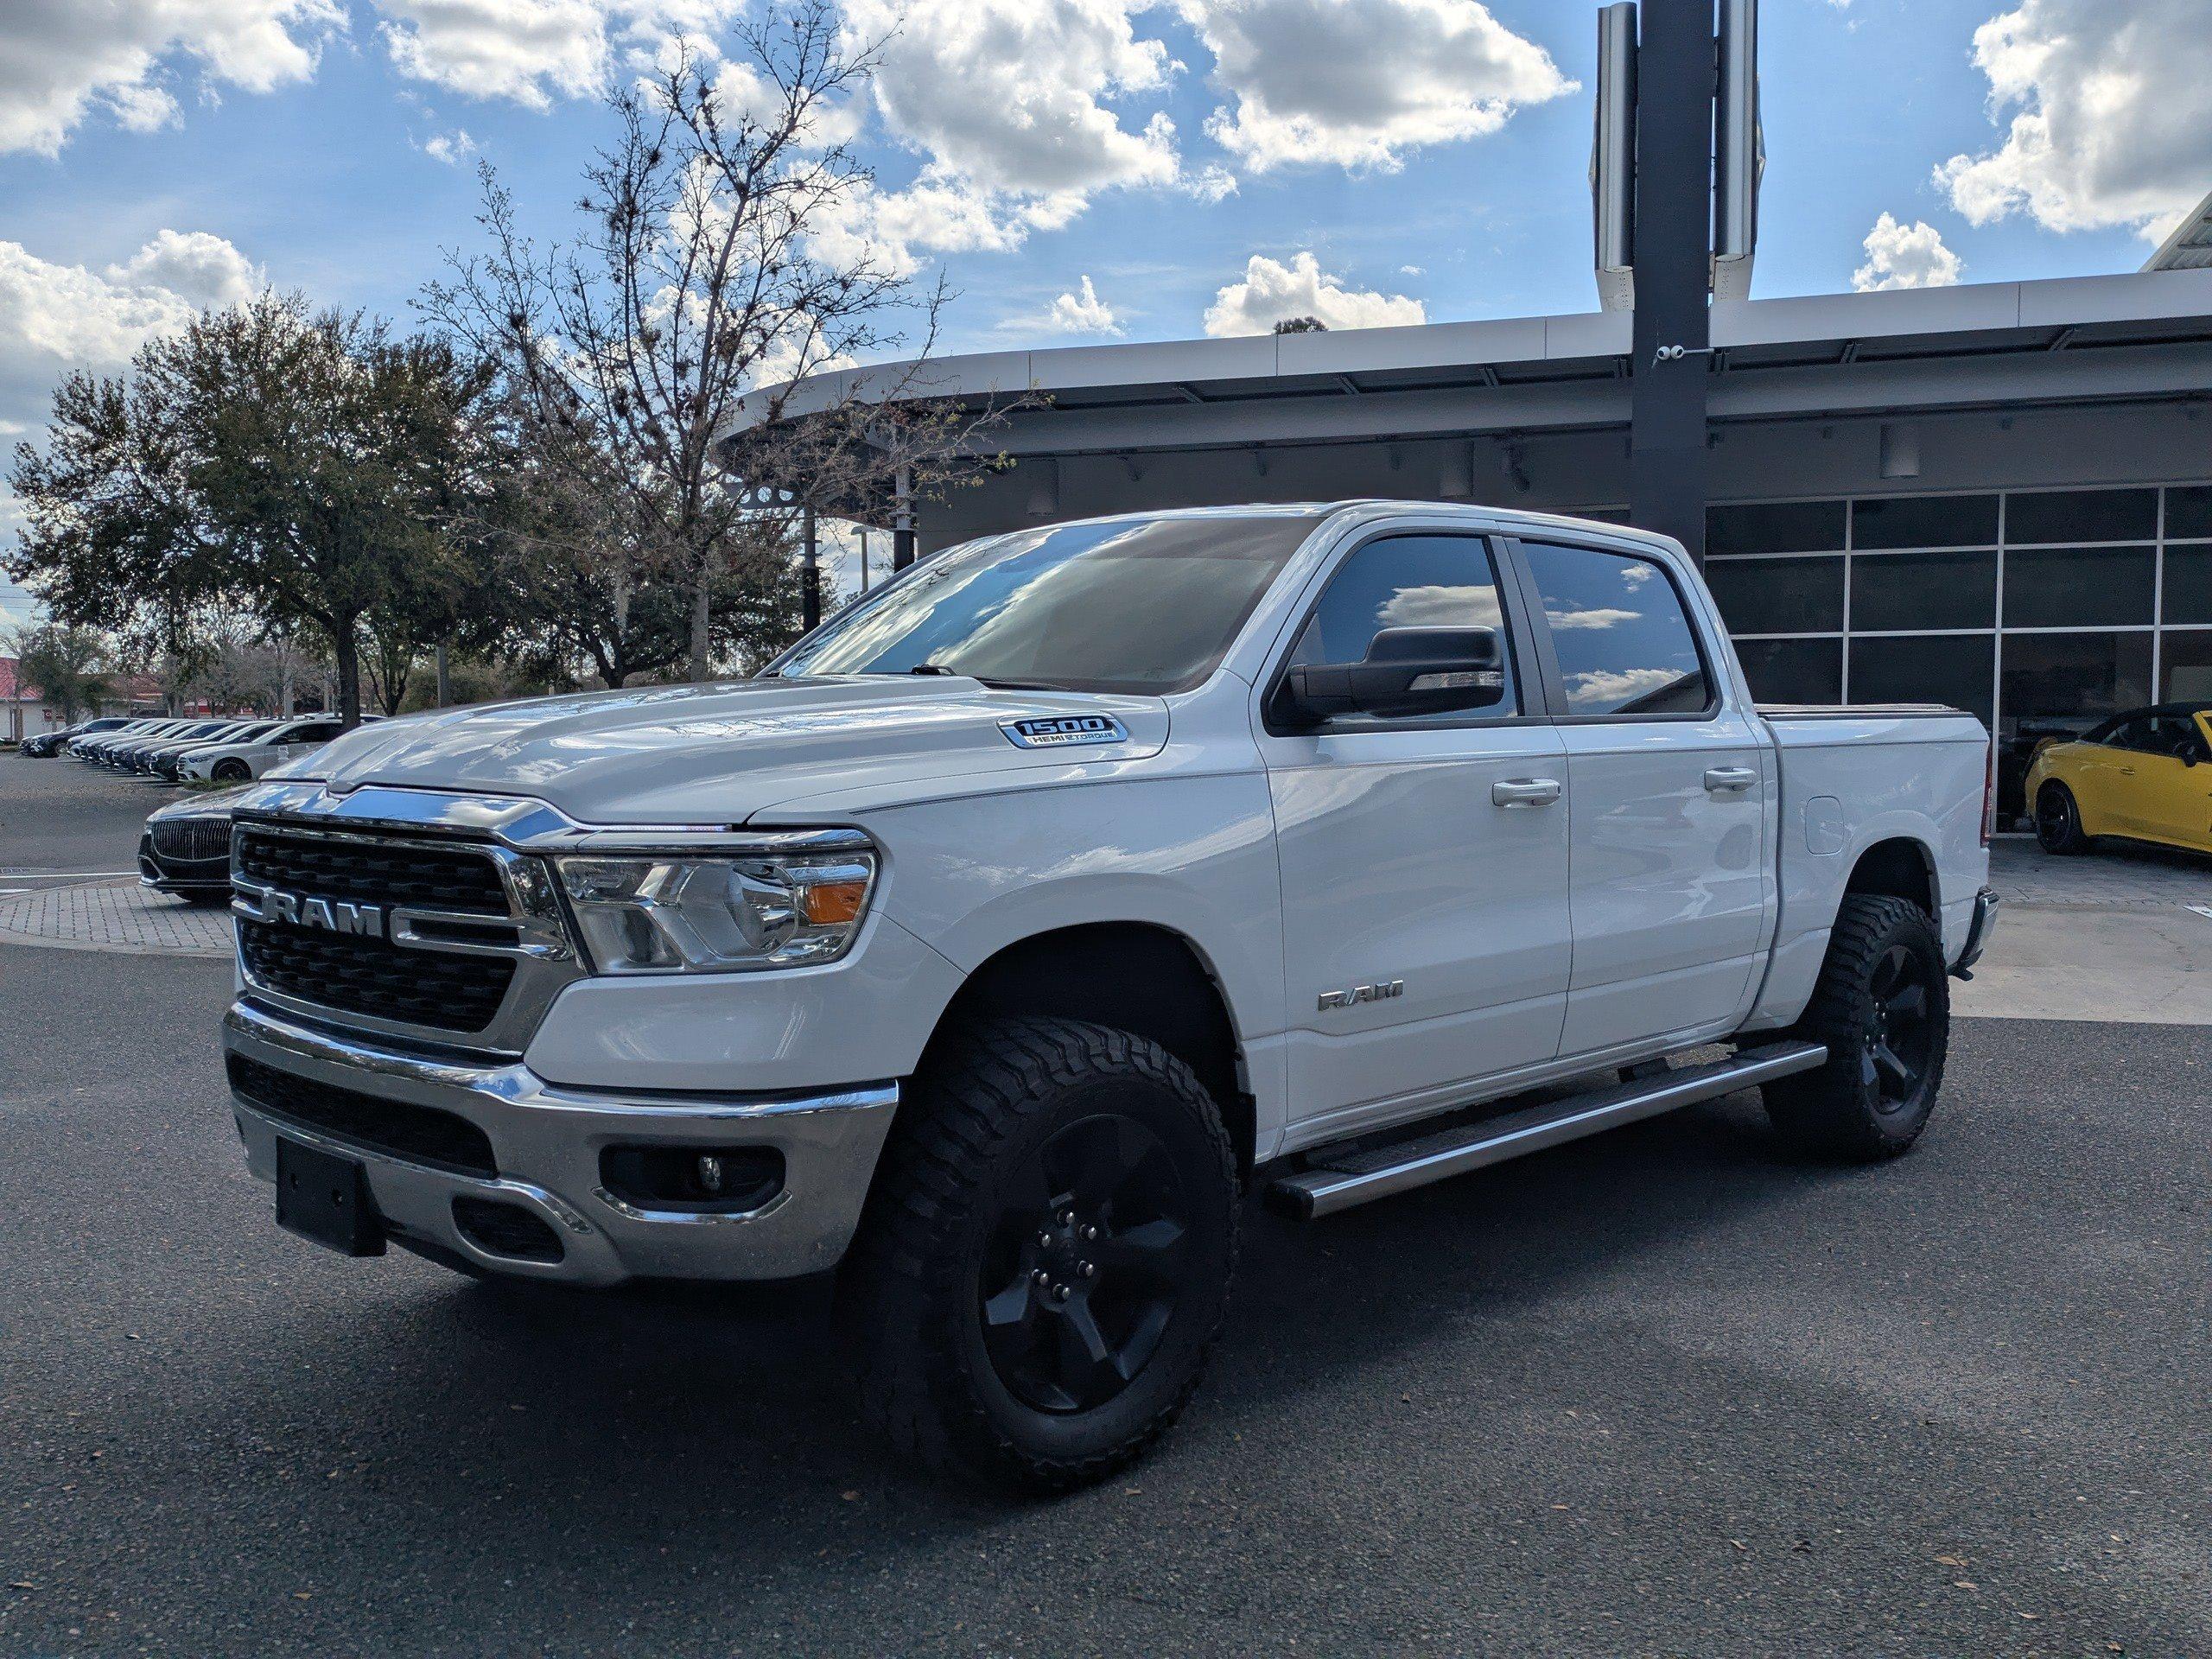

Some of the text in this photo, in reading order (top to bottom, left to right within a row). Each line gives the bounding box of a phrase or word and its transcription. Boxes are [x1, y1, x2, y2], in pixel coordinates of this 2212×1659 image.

[1020, 718, 1105, 734] 1500
[1033, 734, 1065, 743] HEMI
[262, 887, 383, 938] RAM
[1318, 979, 1403, 1012] RAM
